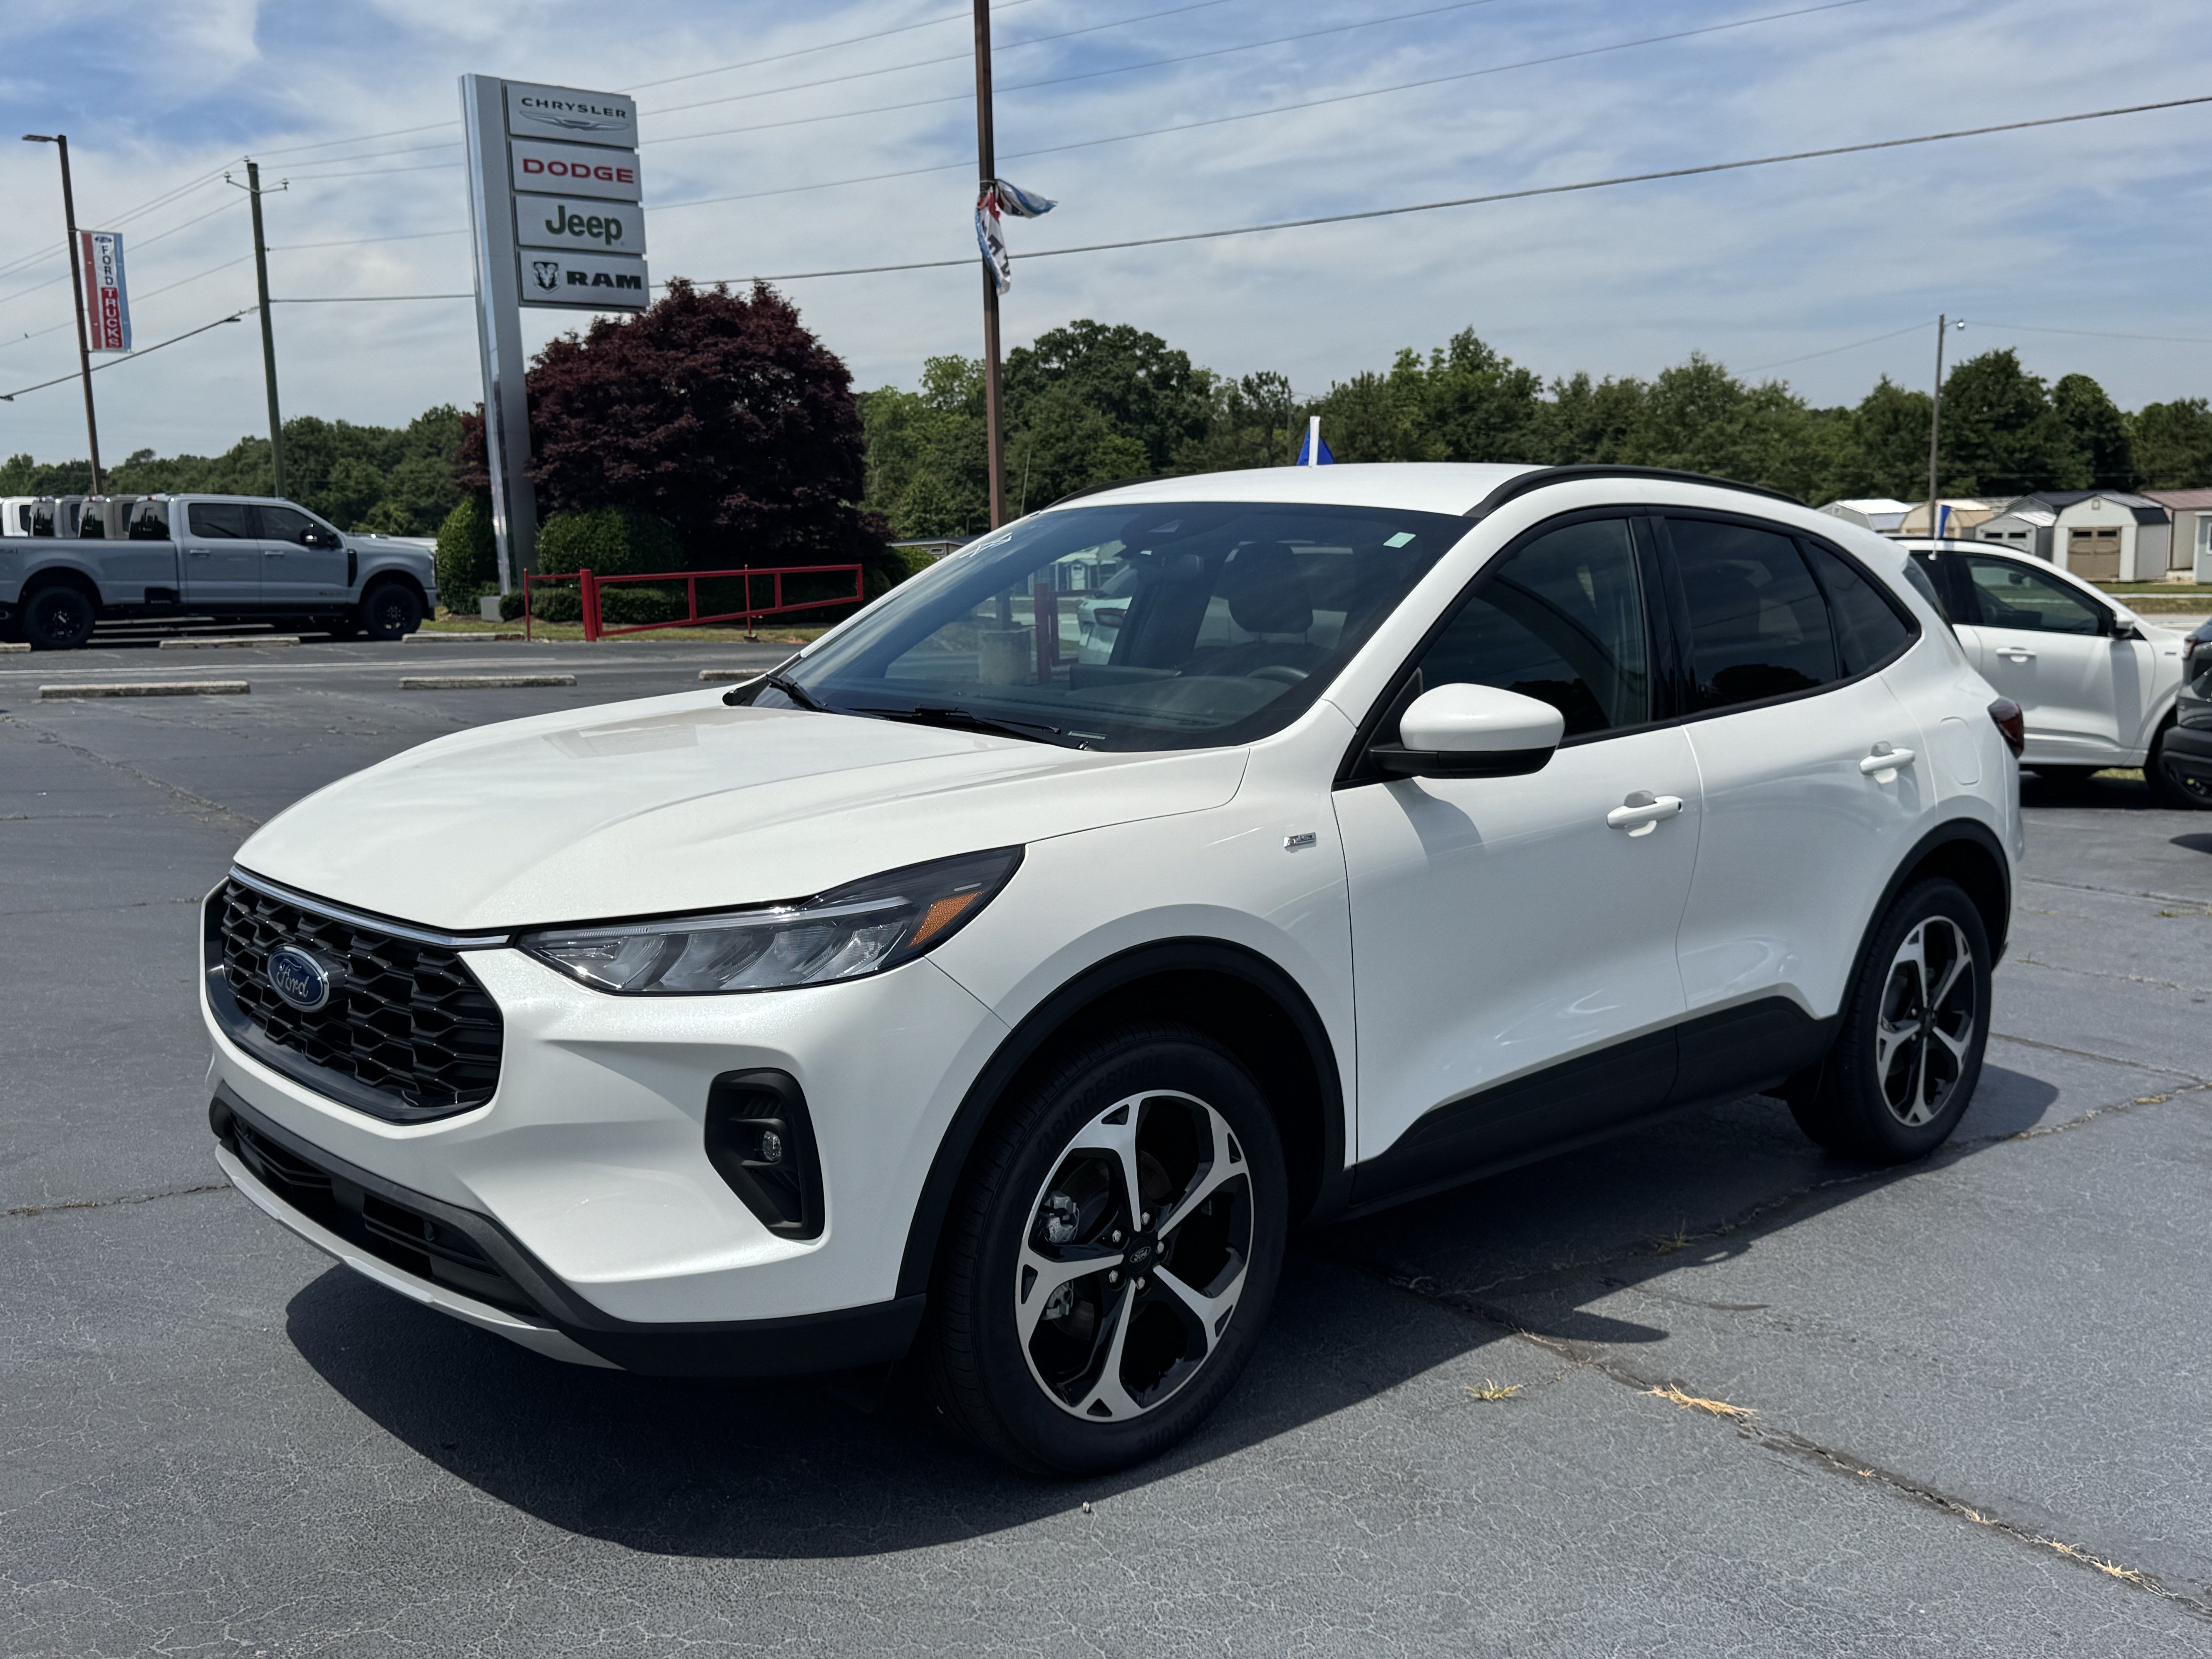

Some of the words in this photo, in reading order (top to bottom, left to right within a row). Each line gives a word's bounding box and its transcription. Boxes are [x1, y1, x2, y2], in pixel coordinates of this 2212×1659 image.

[521, 98, 627, 118] CHRYSLER
[522, 158, 634, 184] DODGE
[545, 205, 623, 245] Jeep
[101, 245, 113, 286] FORD
[566, 271, 642, 290] RAM
[104, 289, 120, 347] TRUCKS
[276, 958, 309, 998] Ford
[1036, 1054, 1164, 1154] BRIDGESTONE
